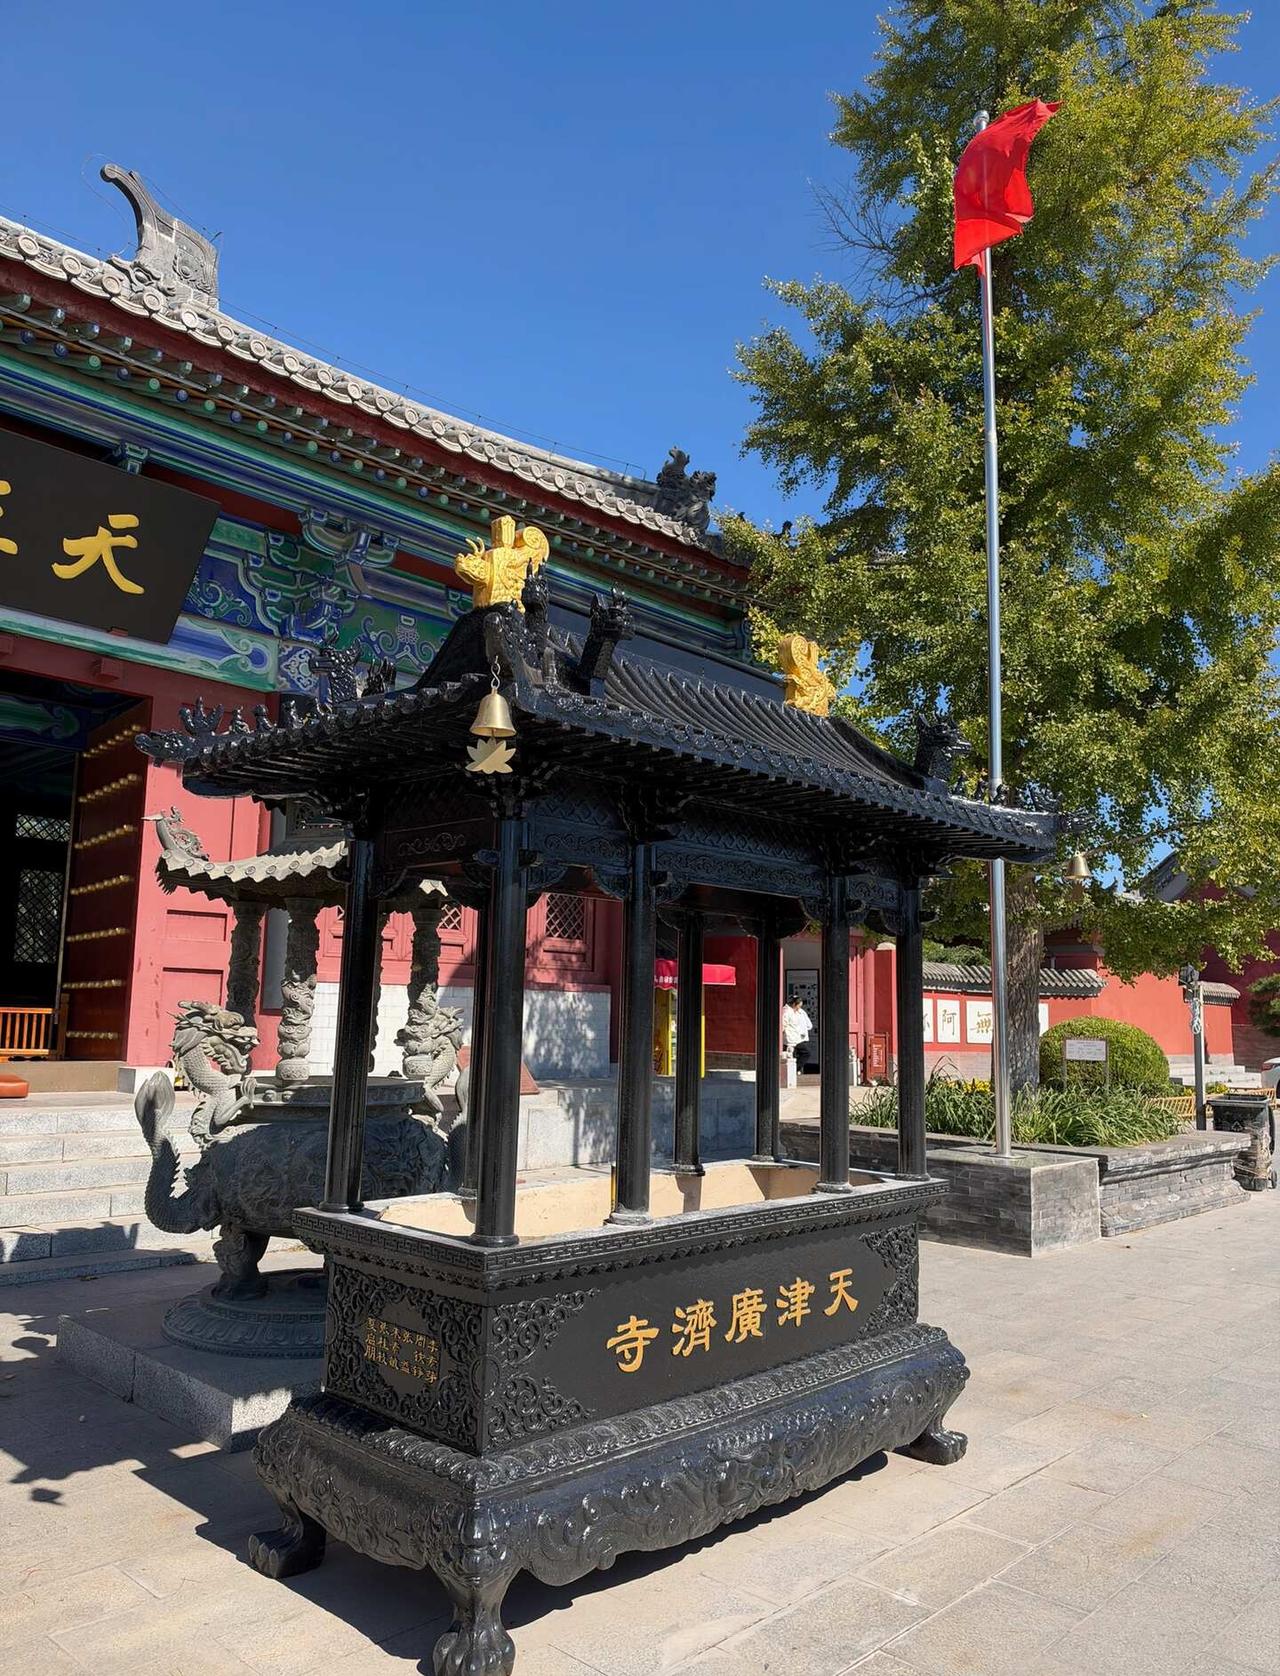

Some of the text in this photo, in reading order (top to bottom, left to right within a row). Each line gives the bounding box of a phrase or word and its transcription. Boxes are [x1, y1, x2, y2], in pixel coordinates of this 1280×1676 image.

[606, 1267, 860, 1373] 天津廣濟寺
